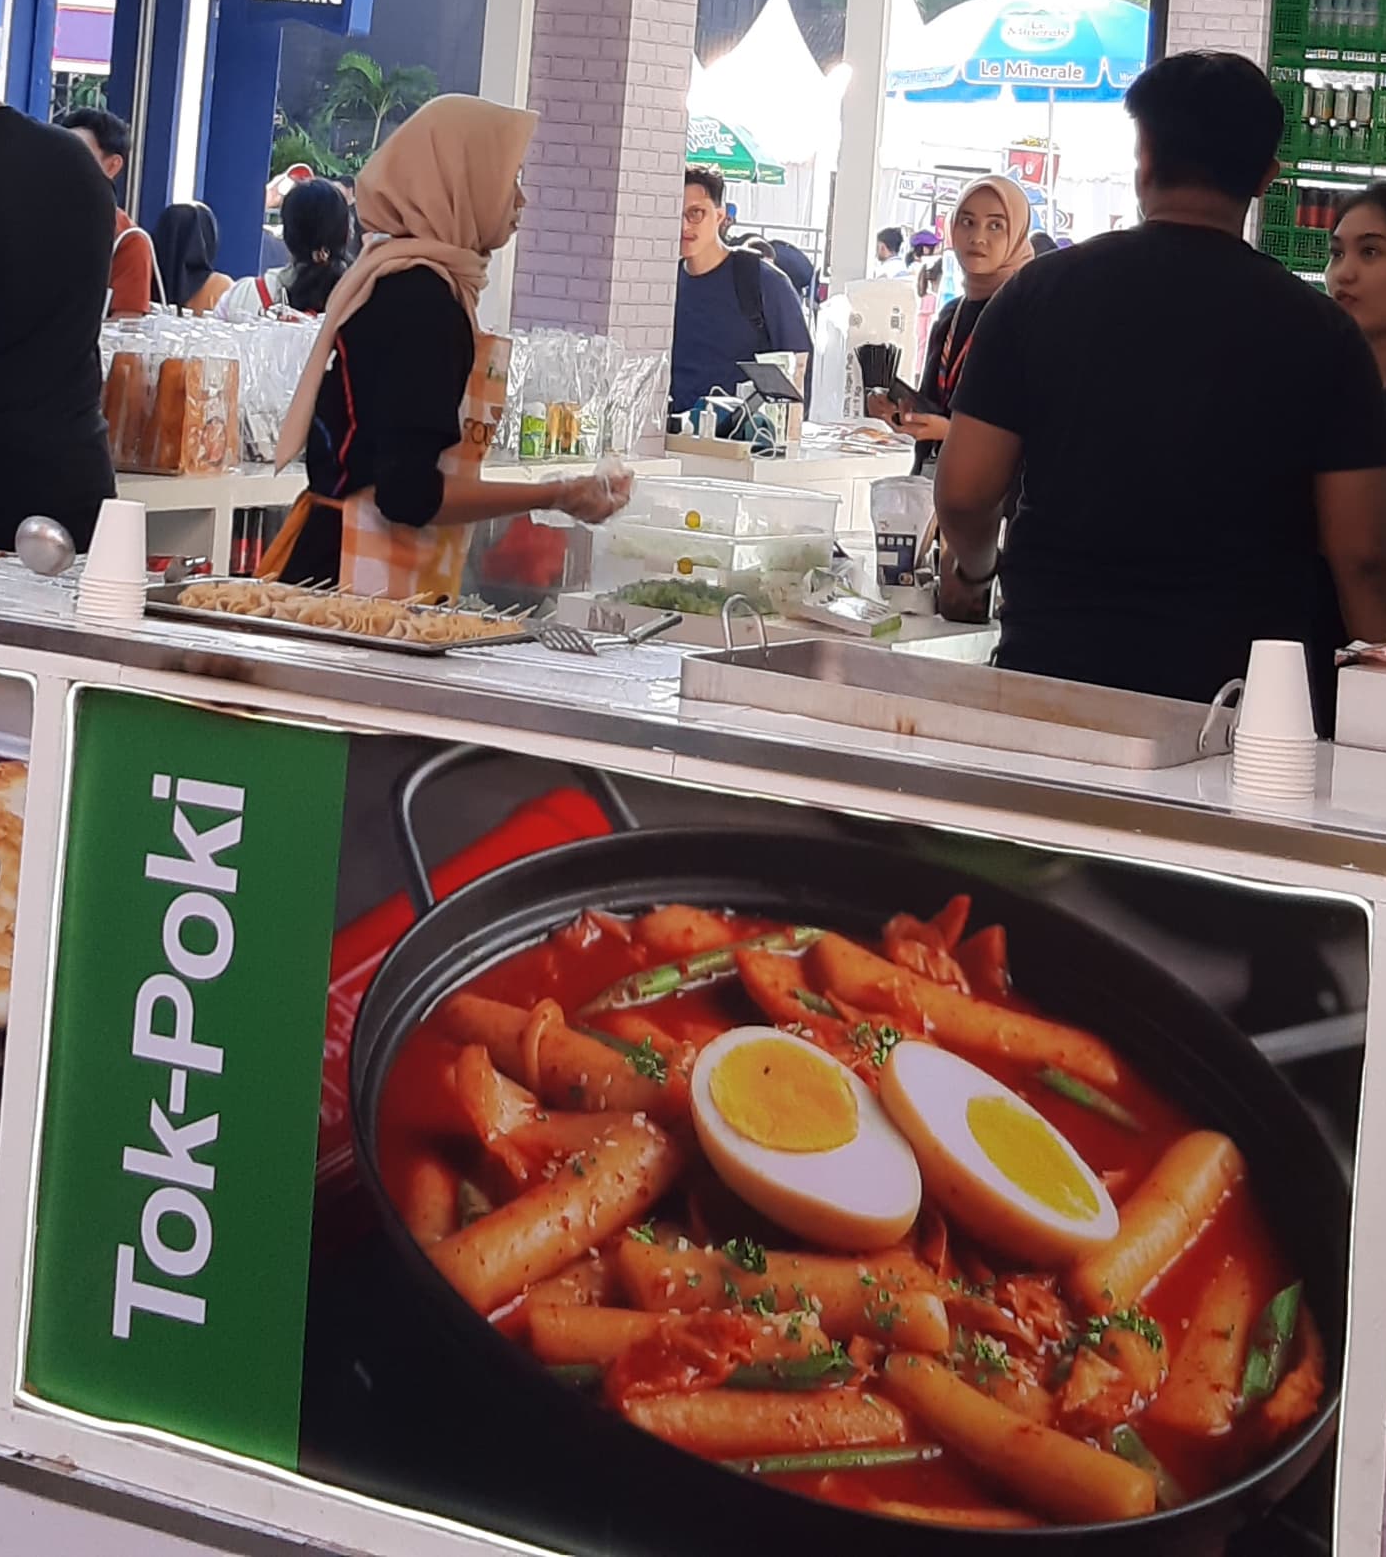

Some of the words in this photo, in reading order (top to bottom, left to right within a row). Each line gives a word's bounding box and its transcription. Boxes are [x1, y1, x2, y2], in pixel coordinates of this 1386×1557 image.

[981, 61, 1000, 76] Le
[1006, 62, 1083, 80] Minerale
[113, 773, 246, 1339] Tok-Poki
